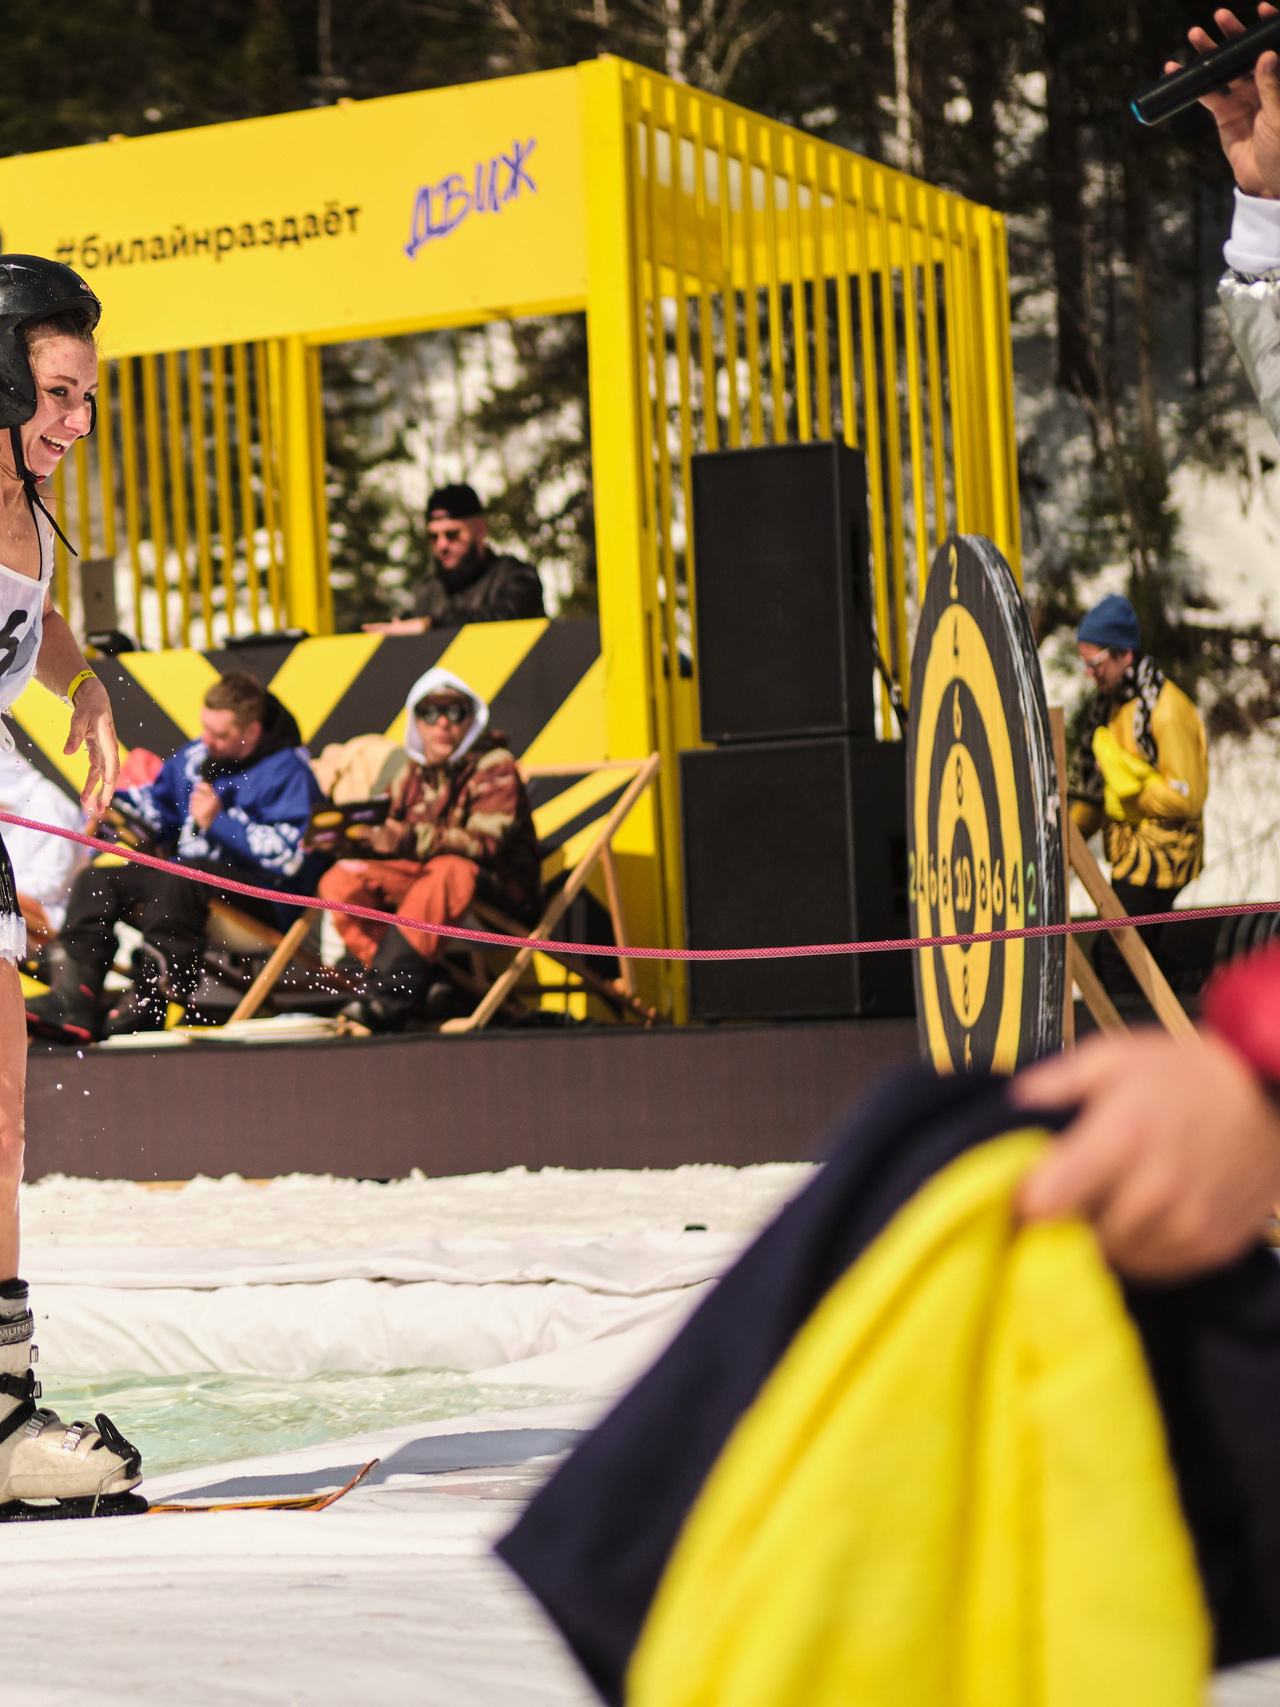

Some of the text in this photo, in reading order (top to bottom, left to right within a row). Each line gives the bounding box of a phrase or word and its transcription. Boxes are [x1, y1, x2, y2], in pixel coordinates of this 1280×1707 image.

[55, 138, 537, 270] #билайнраздаёт ДВИЖ
[948, 543, 959, 600] 2
[952, 615, 960, 666] 4
[952, 683, 963, 740] 6
[956, 755, 964, 806] 8
[908, 850, 1037, 917] 2 4 6 8 10 8 6 4 2
[962, 964, 970, 1016] 8
